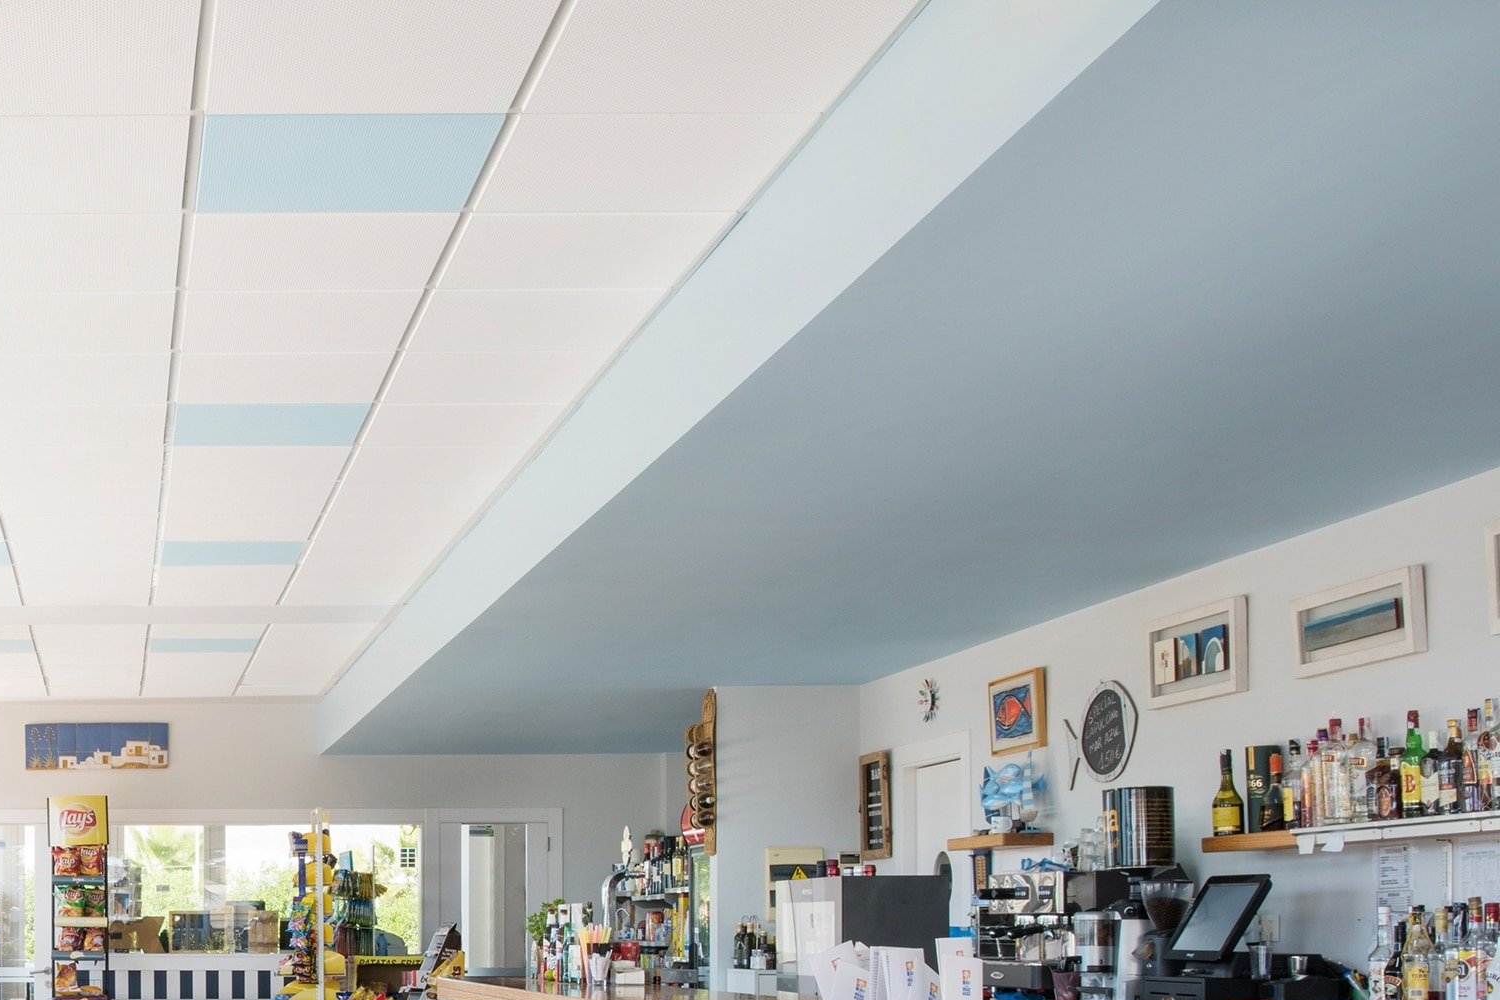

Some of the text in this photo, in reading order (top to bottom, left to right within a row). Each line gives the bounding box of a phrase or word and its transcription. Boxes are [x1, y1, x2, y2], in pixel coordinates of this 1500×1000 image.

[1088, 695, 1117, 725] SPECIAL
[1089, 725, 1121, 755] MAR AZUL
[61, 808, 95, 833] Lay's
